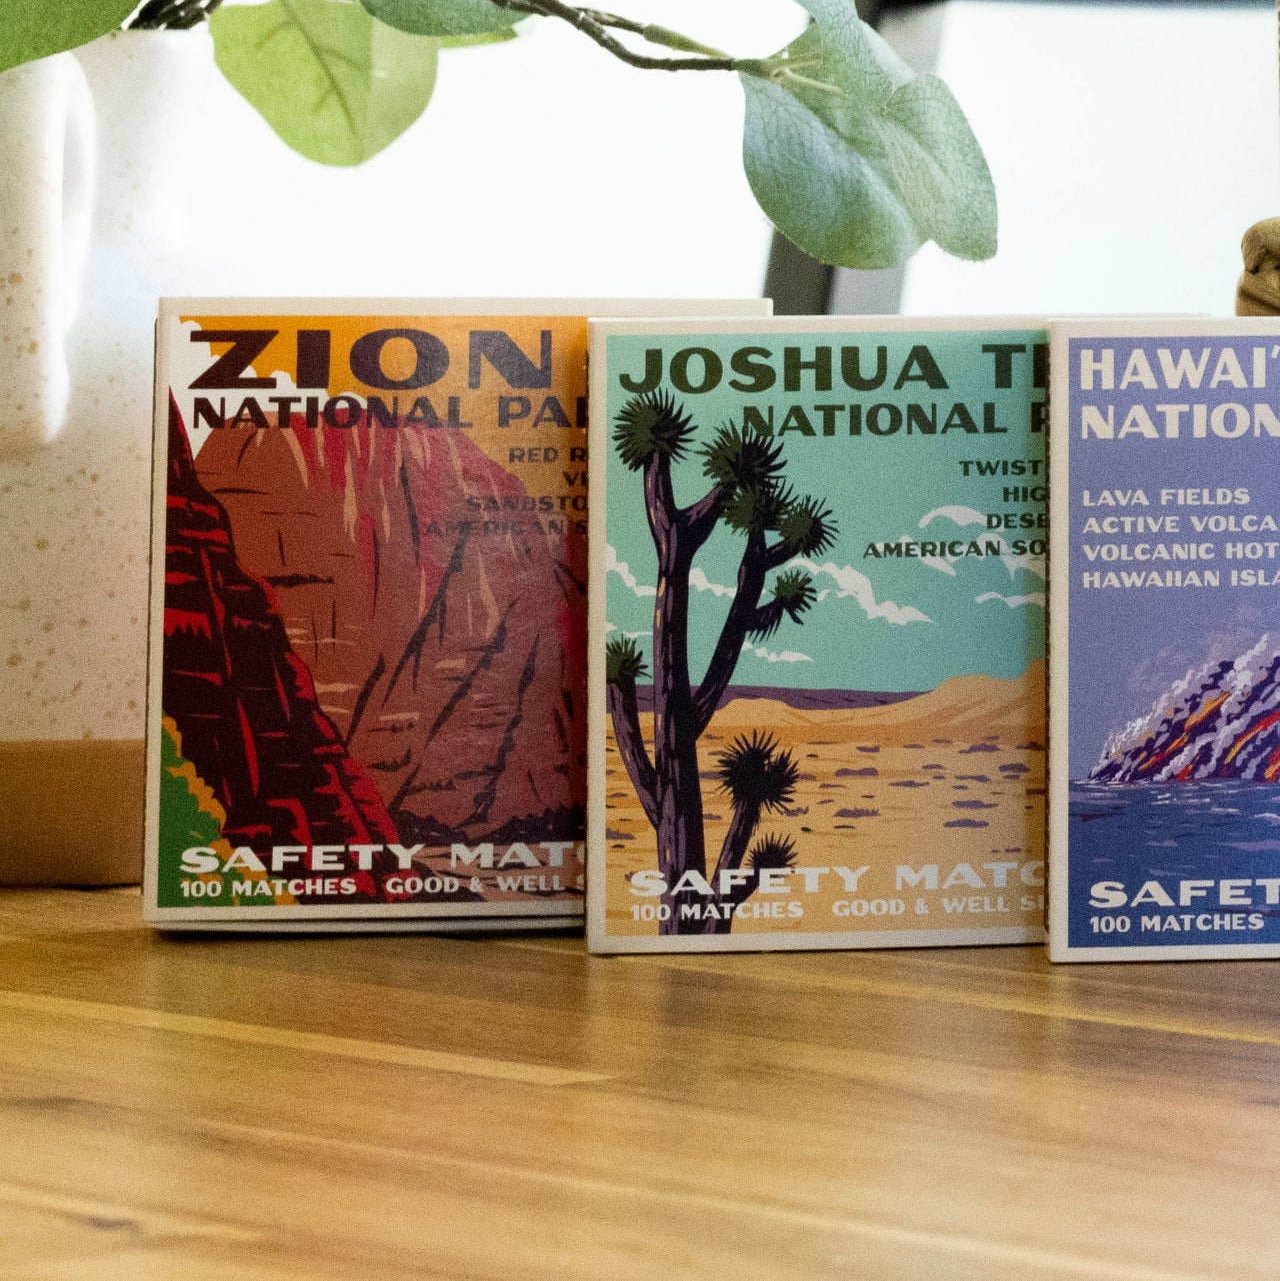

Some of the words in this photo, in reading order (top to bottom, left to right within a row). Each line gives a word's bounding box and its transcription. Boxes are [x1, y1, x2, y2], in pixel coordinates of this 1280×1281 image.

[188, 329, 552, 390] ZION
[619, 345, 949, 394] JOSHUA
[193, 396, 472, 429] NATIONAL
[742, 402, 1007, 437] NATIONAL
[509, 447, 558, 463] RED
[1082, 490, 1149, 506] LAVA
[1160, 488, 1250, 505] FIELDS
[1082, 517, 1179, 534] ACTIVE
[863, 540, 1000, 559] AMERICAN
[1082, 543, 1215, 561] VOLCANIC
[1082, 570, 1220, 588] HAWAIIAN
[179, 844, 428, 873] SAFETY
[180, 881, 221, 898] 100
[232, 878, 358, 895] MATCHES
[385, 876, 460, 893] GOOD
[497, 875, 566, 891] WELL
[629, 865, 870, 897] SAFETY
[631, 904, 671, 922] 100
[681, 901, 804, 920] MATCHES
[831, 898, 906, 917] GOOD
[941, 896, 1009, 914] WELL
[1089, 916, 1131, 933] 100
[1140, 913, 1265, 932] MATCHES
